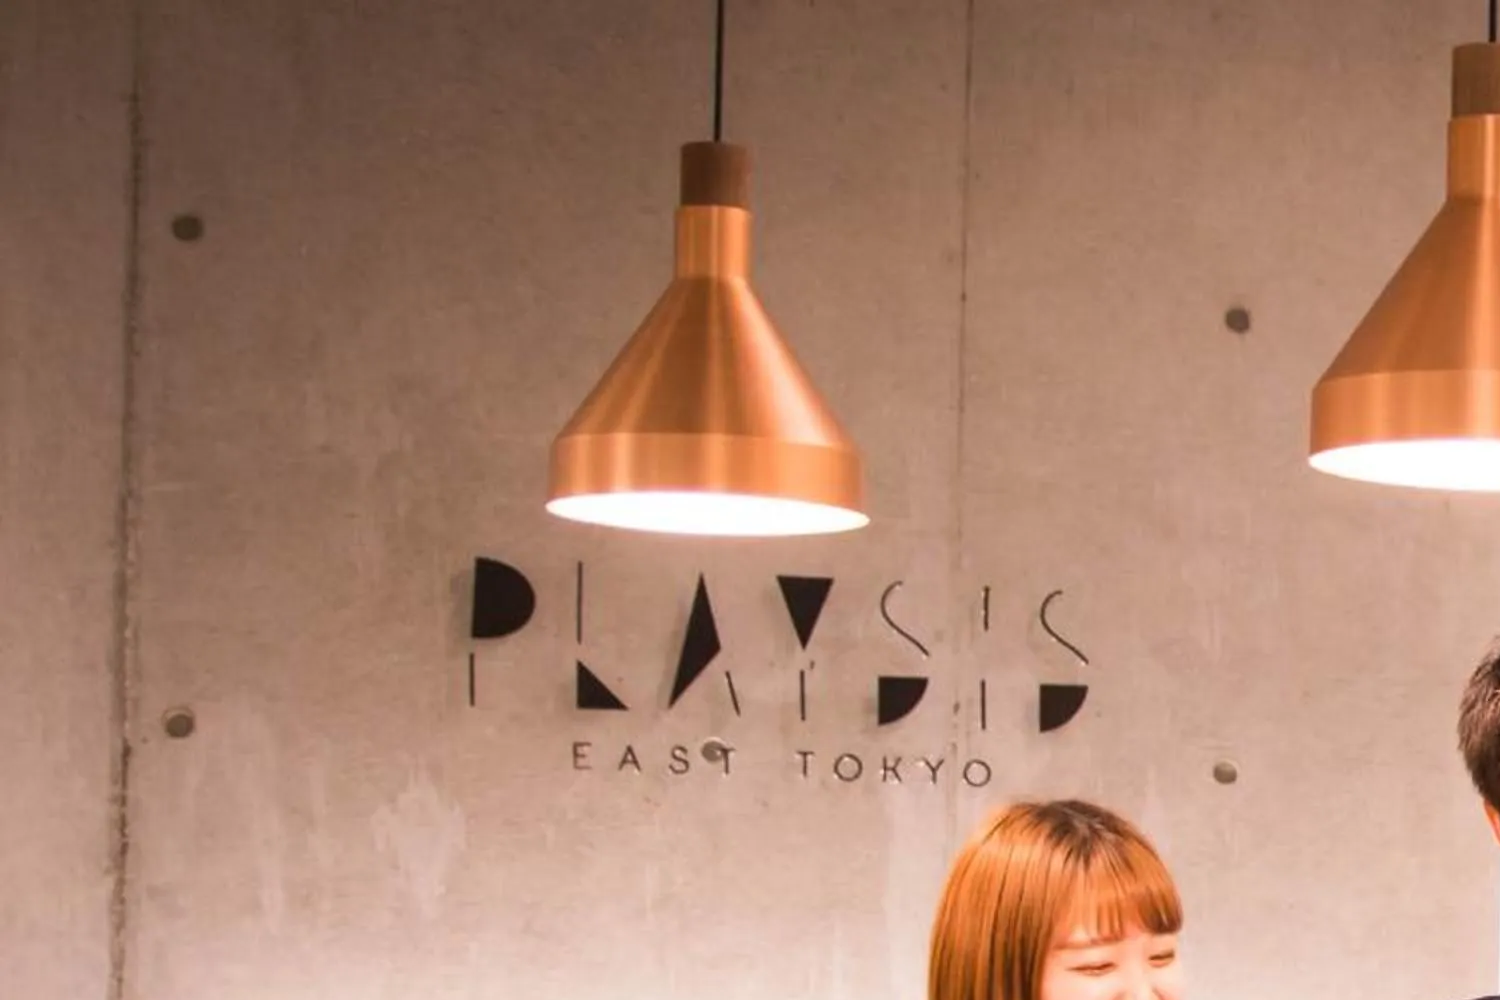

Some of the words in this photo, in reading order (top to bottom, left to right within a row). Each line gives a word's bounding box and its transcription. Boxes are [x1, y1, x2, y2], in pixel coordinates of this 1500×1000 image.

[469, 556, 1090, 732] PLAYSIS
[572, 741, 735, 776] EAST
[799, 749, 993, 788] TOKYO
